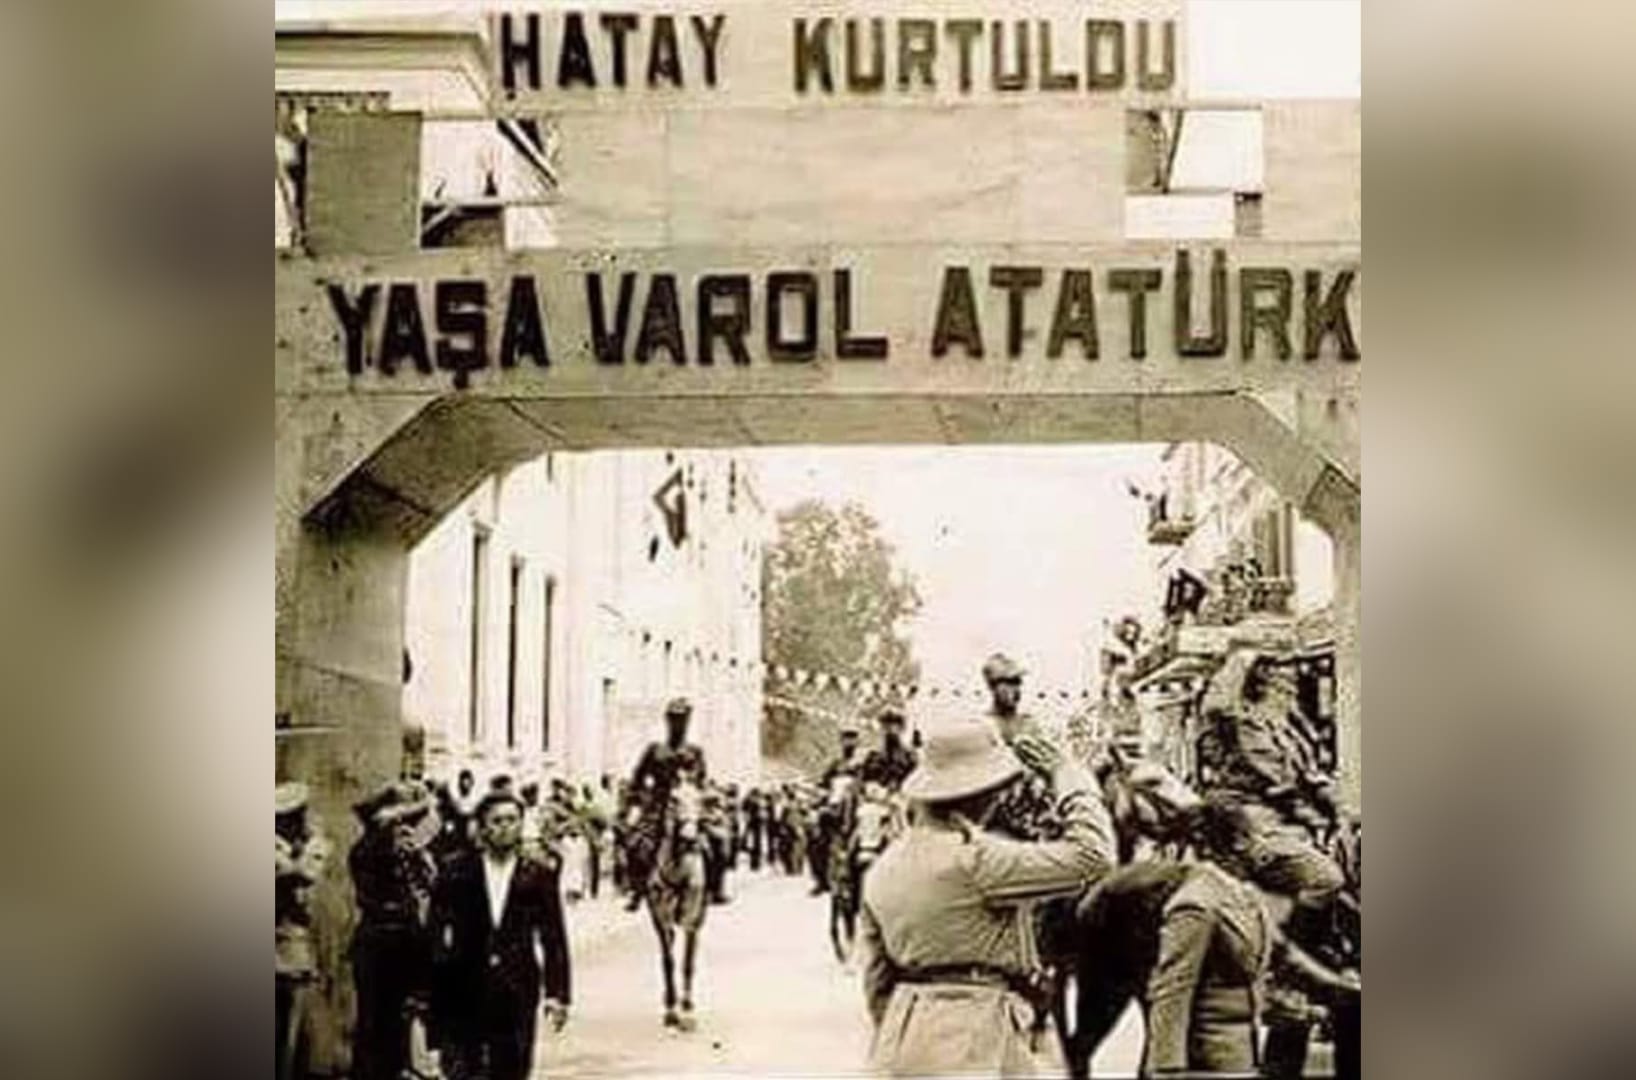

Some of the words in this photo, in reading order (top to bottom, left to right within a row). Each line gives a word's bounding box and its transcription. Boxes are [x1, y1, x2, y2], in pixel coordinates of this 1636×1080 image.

[501, 12, 726, 90] HATAY
[793, 17, 1178, 94] KURTULDU
[327, 274, 550, 389] YAŞA
[586, 271, 889, 367] VAROL
[929, 248, 1361, 363] ATATÜRK
